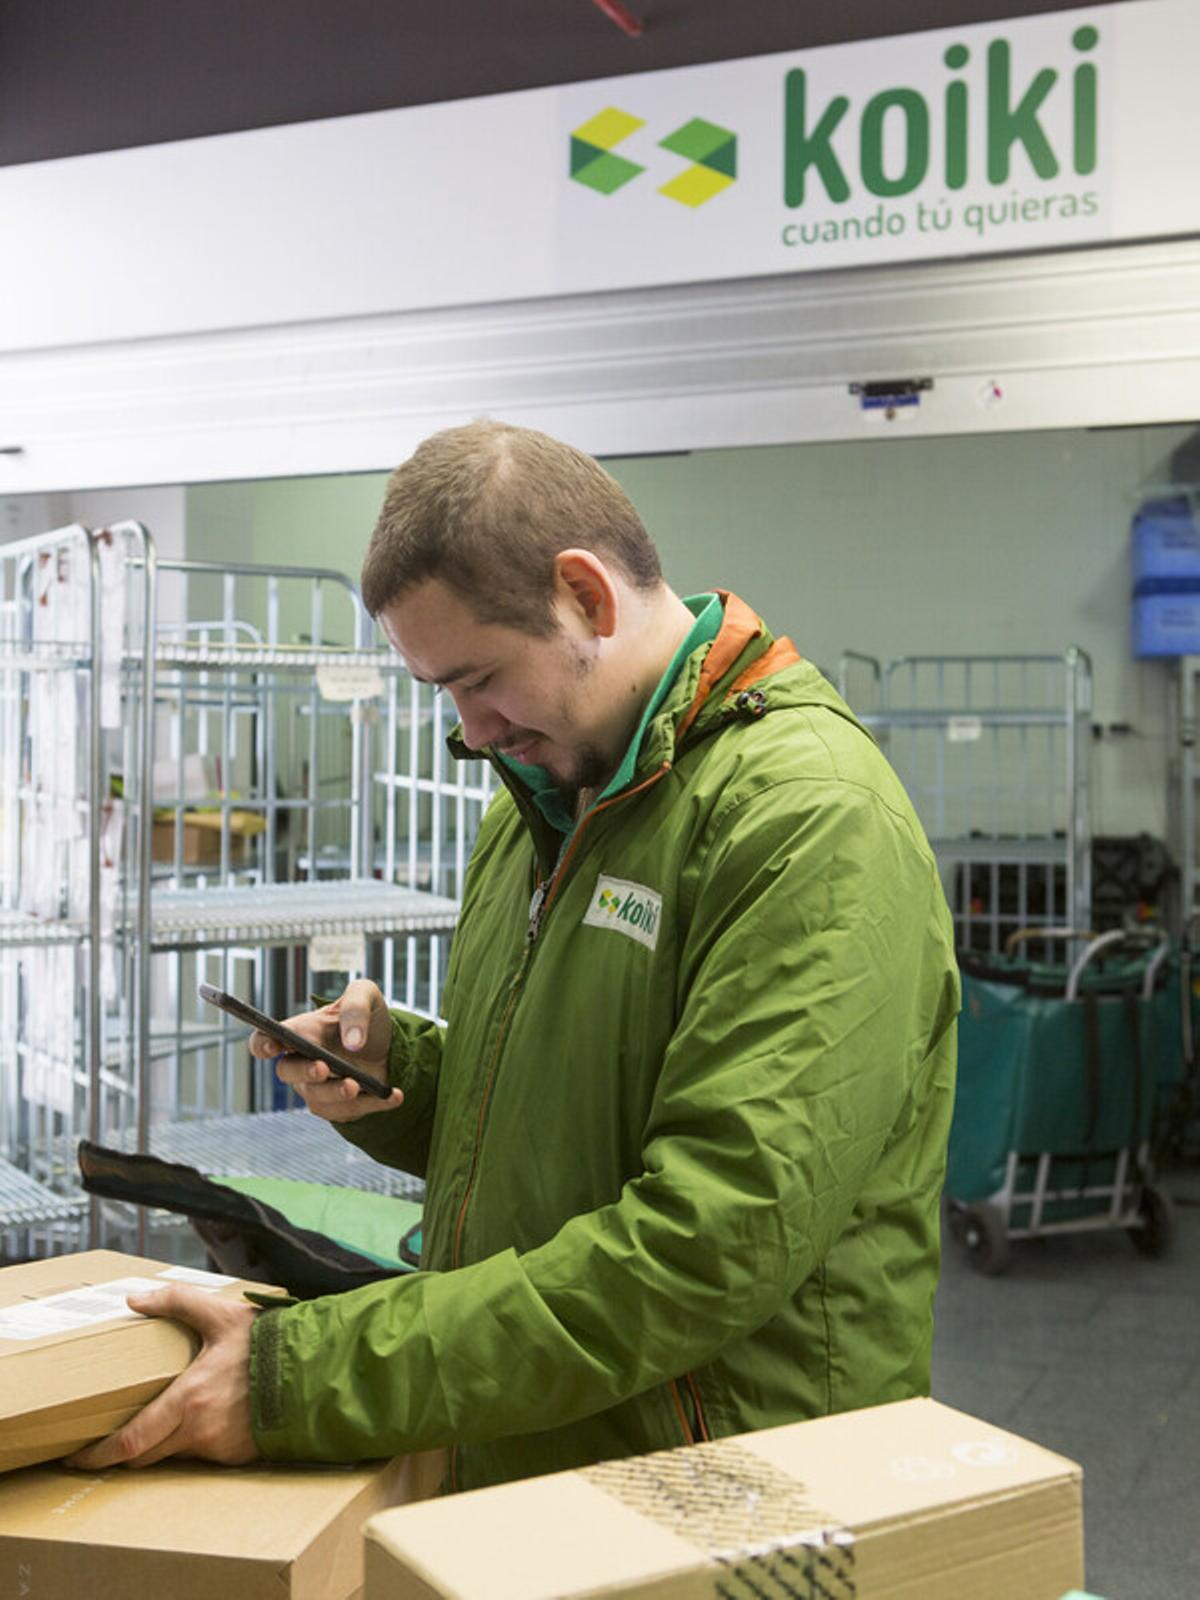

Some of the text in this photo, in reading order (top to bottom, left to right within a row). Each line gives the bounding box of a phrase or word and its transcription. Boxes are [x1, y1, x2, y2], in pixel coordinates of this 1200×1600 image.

[785, 25, 1099, 208] koiki
[782, 190, 1098, 246] cuando tú quieras
